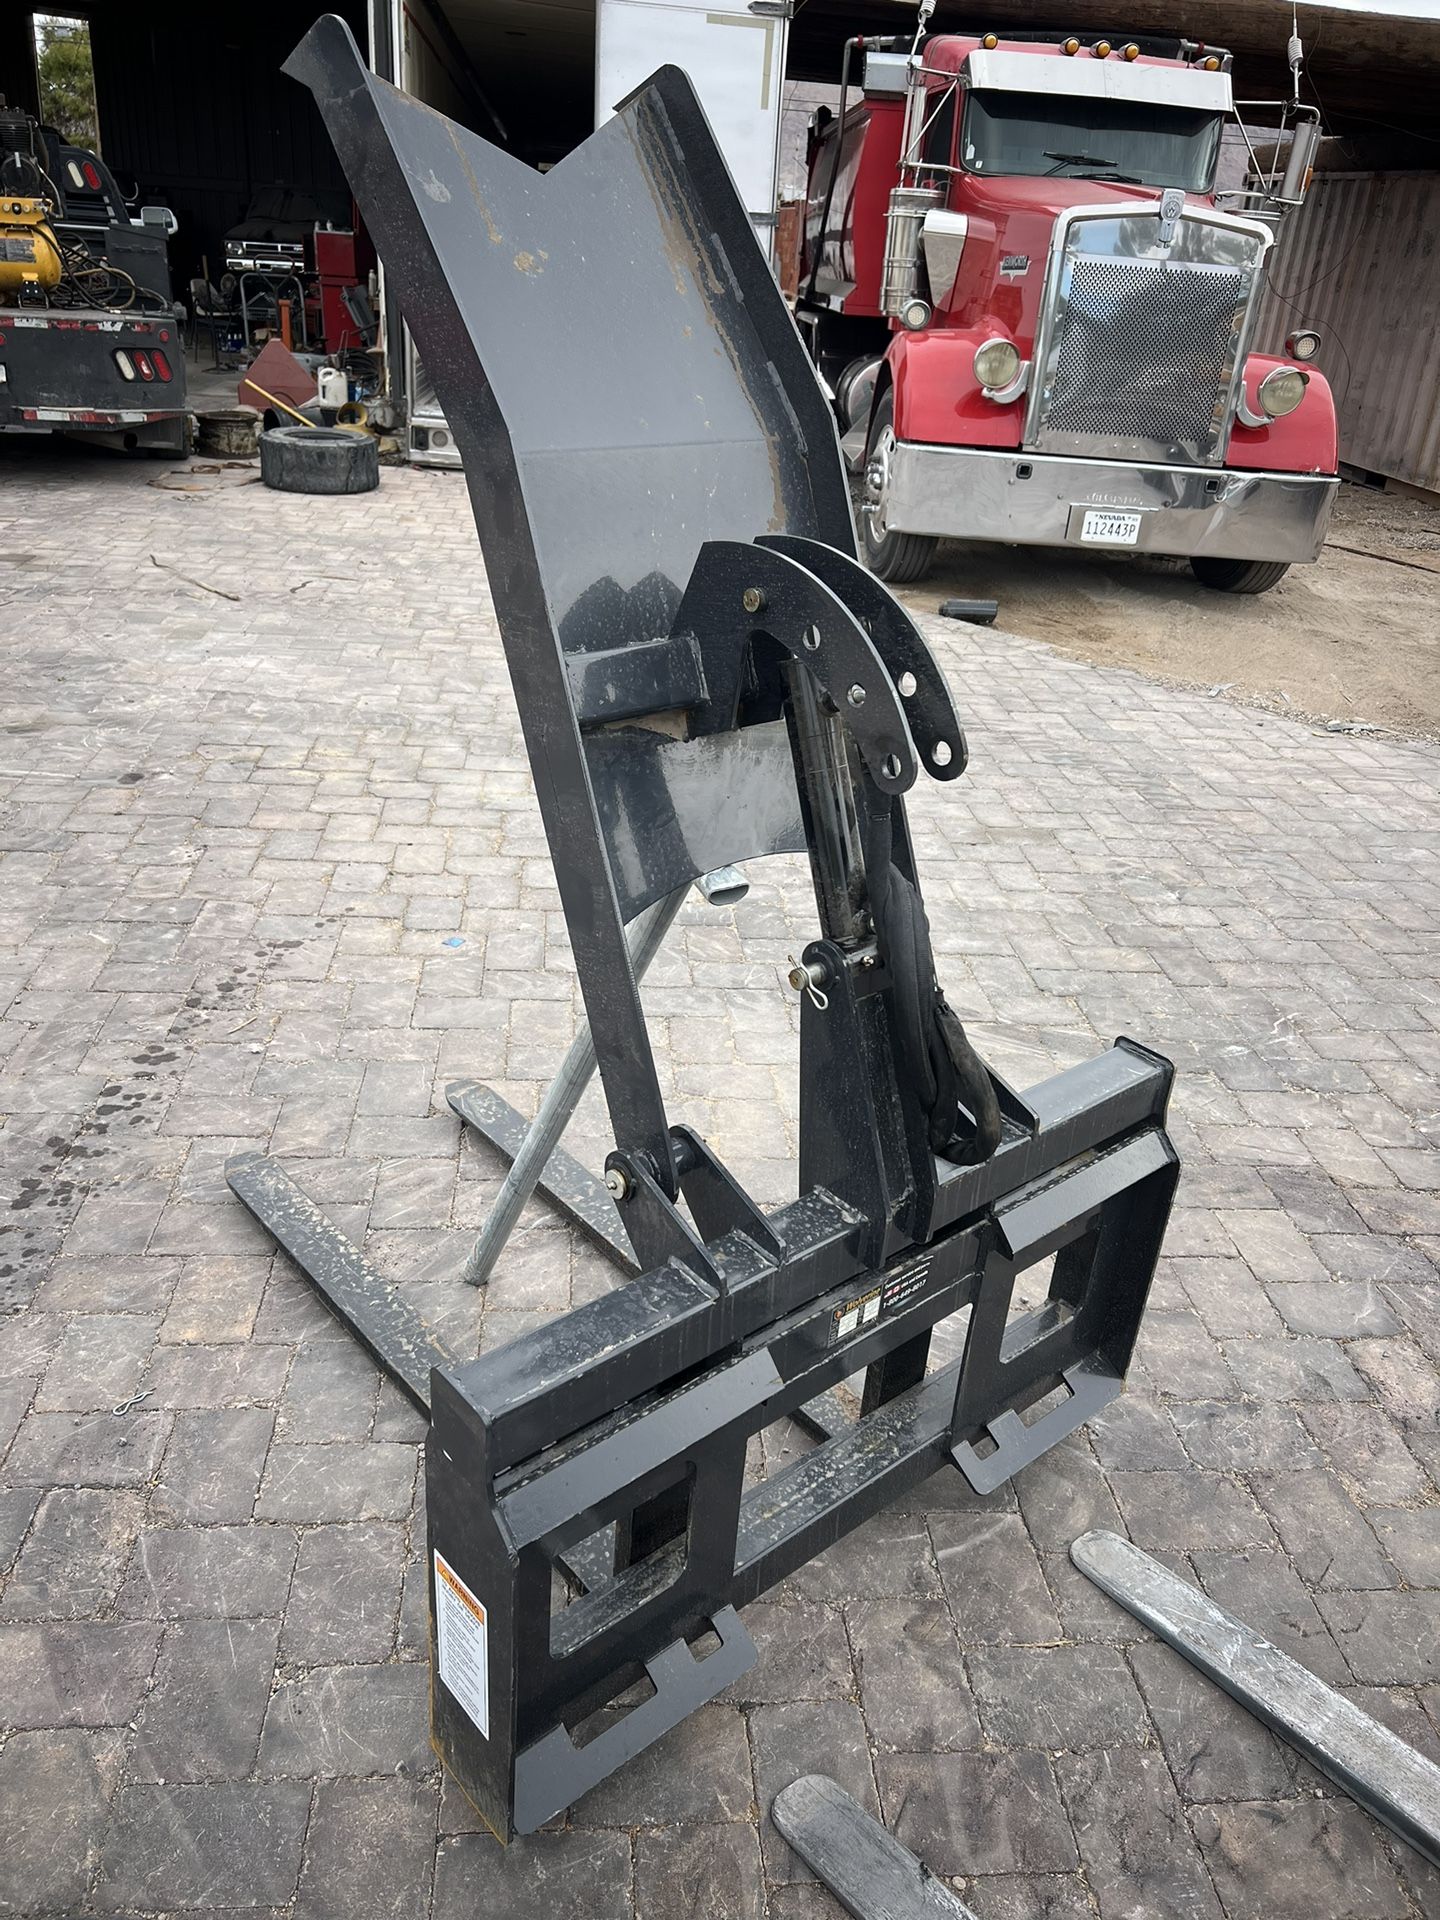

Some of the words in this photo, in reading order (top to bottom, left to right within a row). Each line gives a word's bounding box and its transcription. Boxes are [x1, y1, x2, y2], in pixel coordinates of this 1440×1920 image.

[1099, 514, 1126, 522] NEVADA
[1085, 521, 1136, 538] 112443P
[448, 1574, 479, 1616] WARNING
